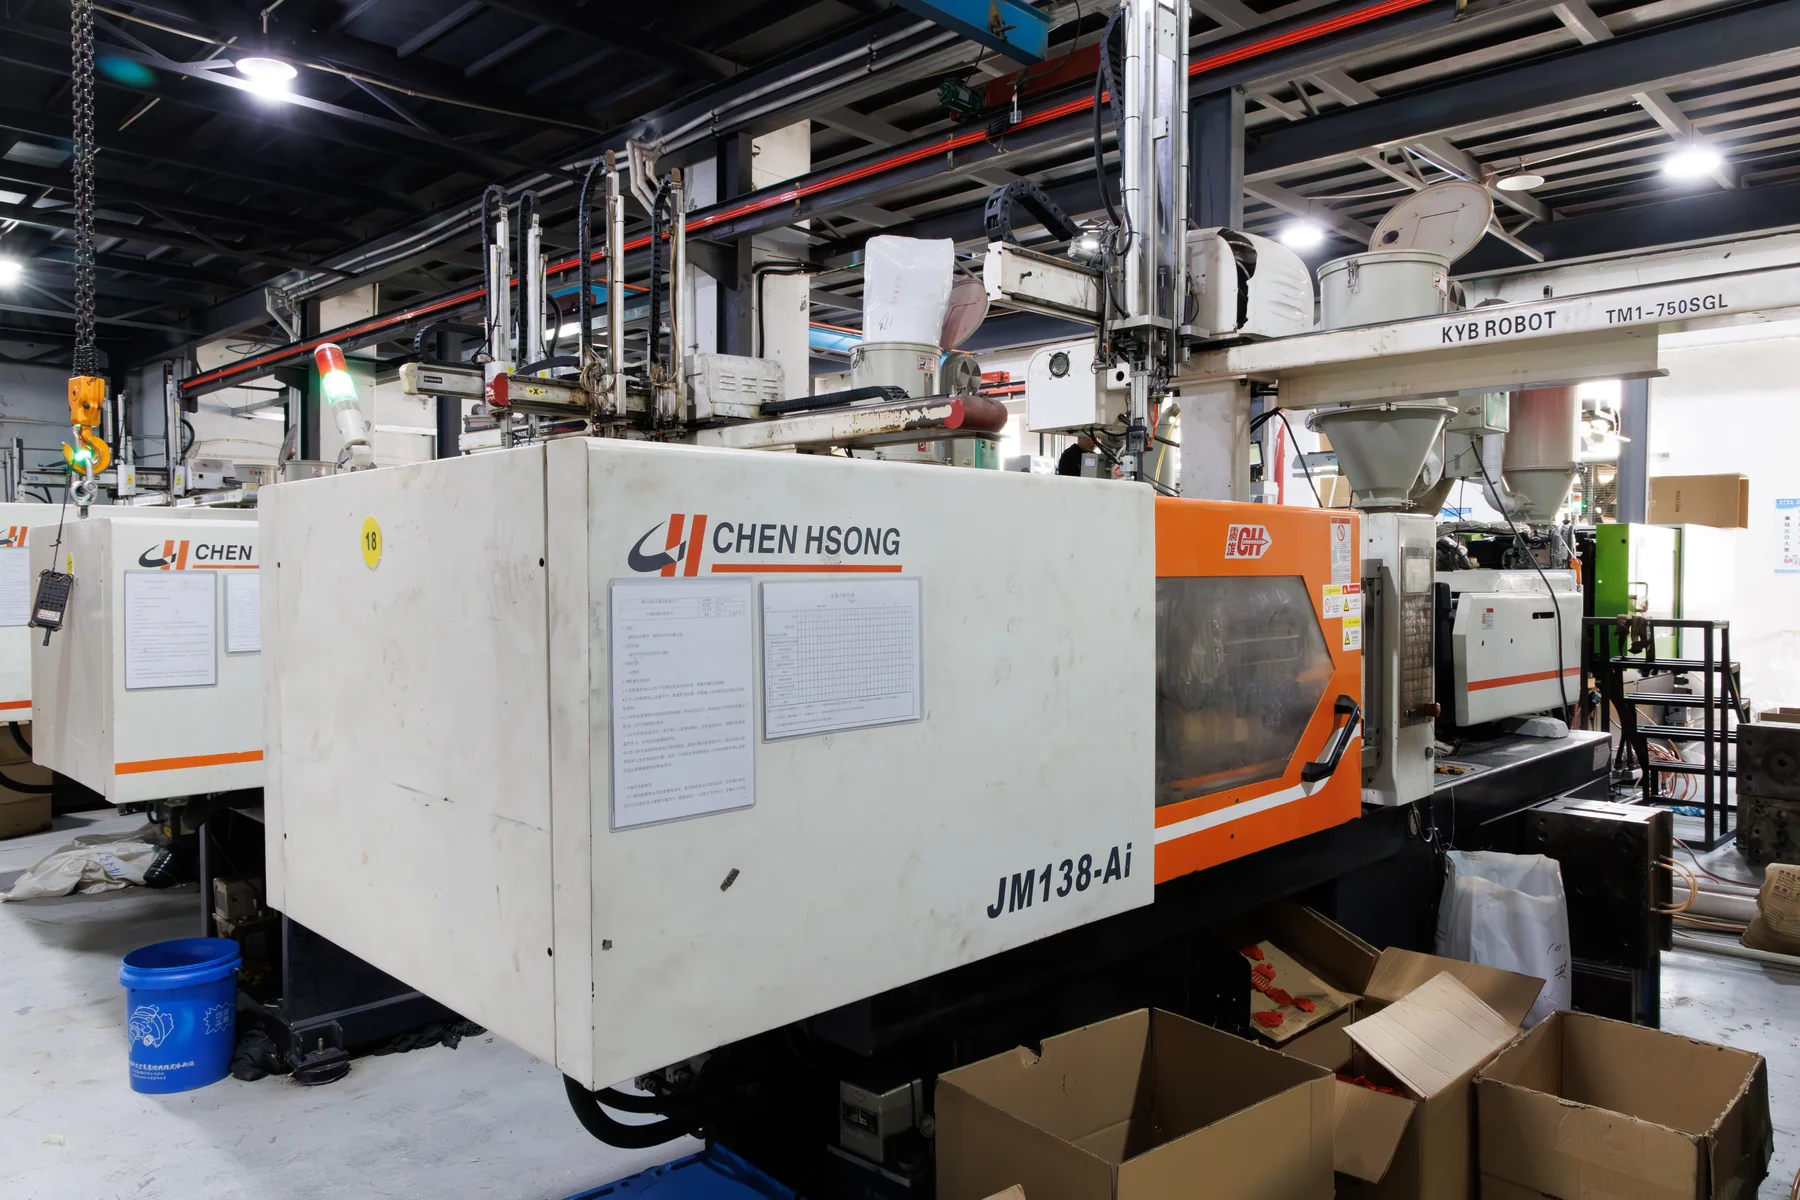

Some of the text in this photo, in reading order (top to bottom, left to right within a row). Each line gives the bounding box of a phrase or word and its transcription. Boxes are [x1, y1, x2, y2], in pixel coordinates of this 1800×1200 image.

[1606, 295, 1728, 324] TM1-750SGL
[1442, 311, 1556, 344] KYB ROBOT
[195, 544, 252, 561] CHEN
[365, 531, 377, 551] 18
[713, 522, 900, 556] CHEN HSONG
[987, 842, 1132, 919] JM138-Ai
